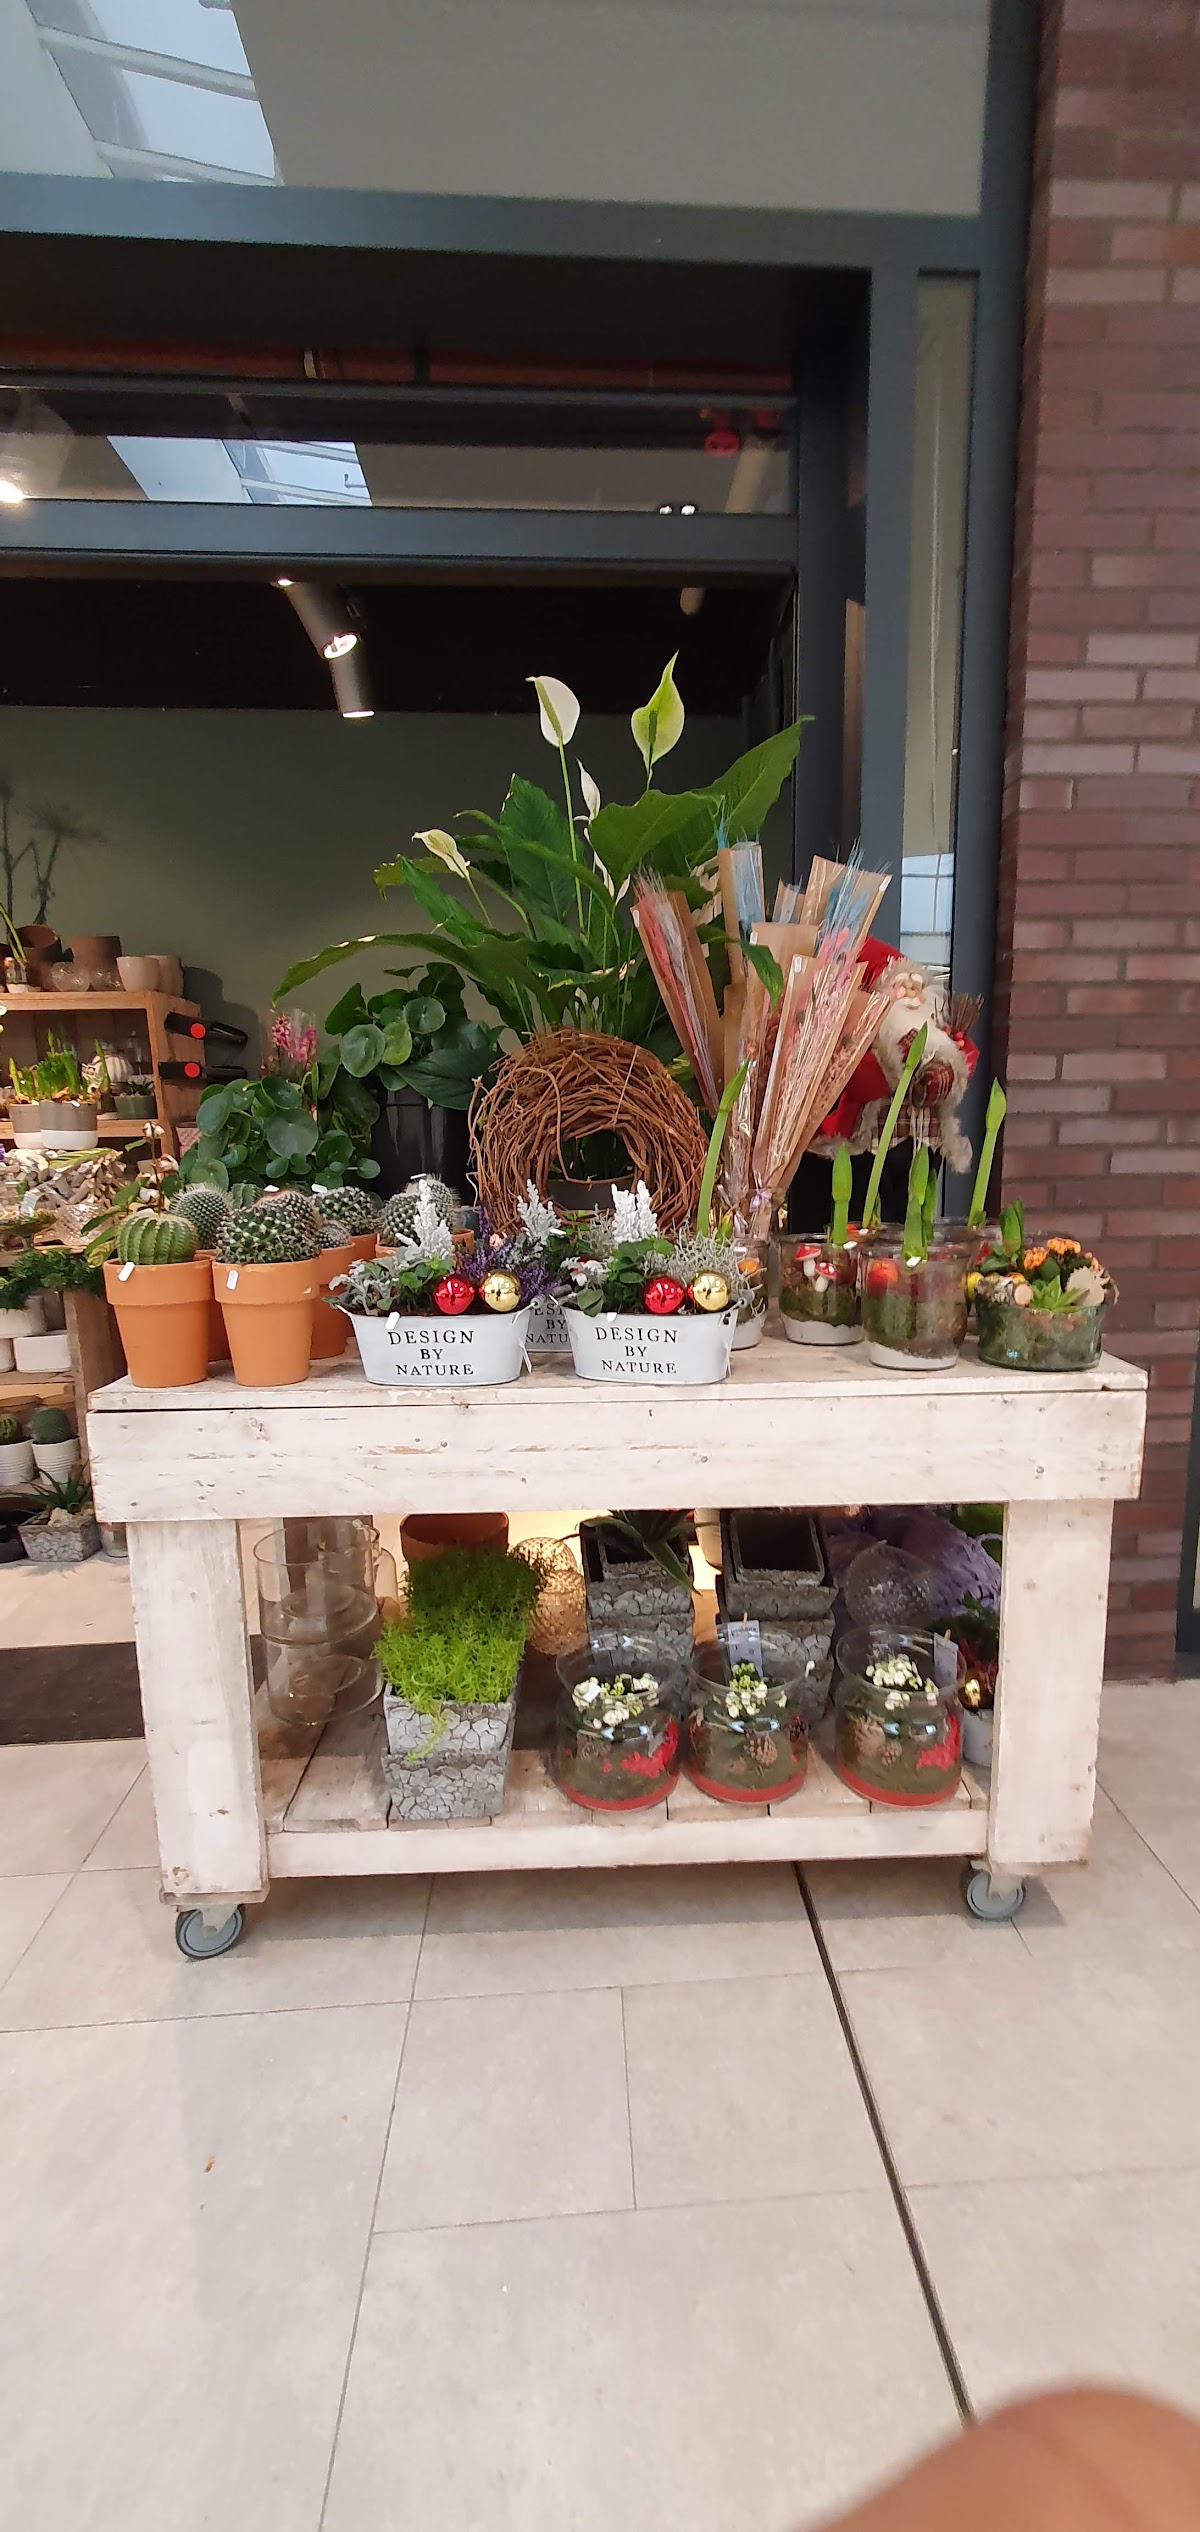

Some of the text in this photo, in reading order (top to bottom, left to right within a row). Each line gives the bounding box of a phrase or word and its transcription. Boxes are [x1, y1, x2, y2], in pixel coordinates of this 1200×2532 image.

[546, 1319, 566, 1330] BY
[388, 1330, 474, 1345] DESIGN
[526, 1333, 568, 1343] NATU
[594, 1327, 678, 1344] DESIGN
[420, 1348, 443, 1360] BY
[625, 1346, 647, 1357] BY
[395, 1364, 474, 1376] NATURE
[601, 1359, 677, 1374] NATURE
